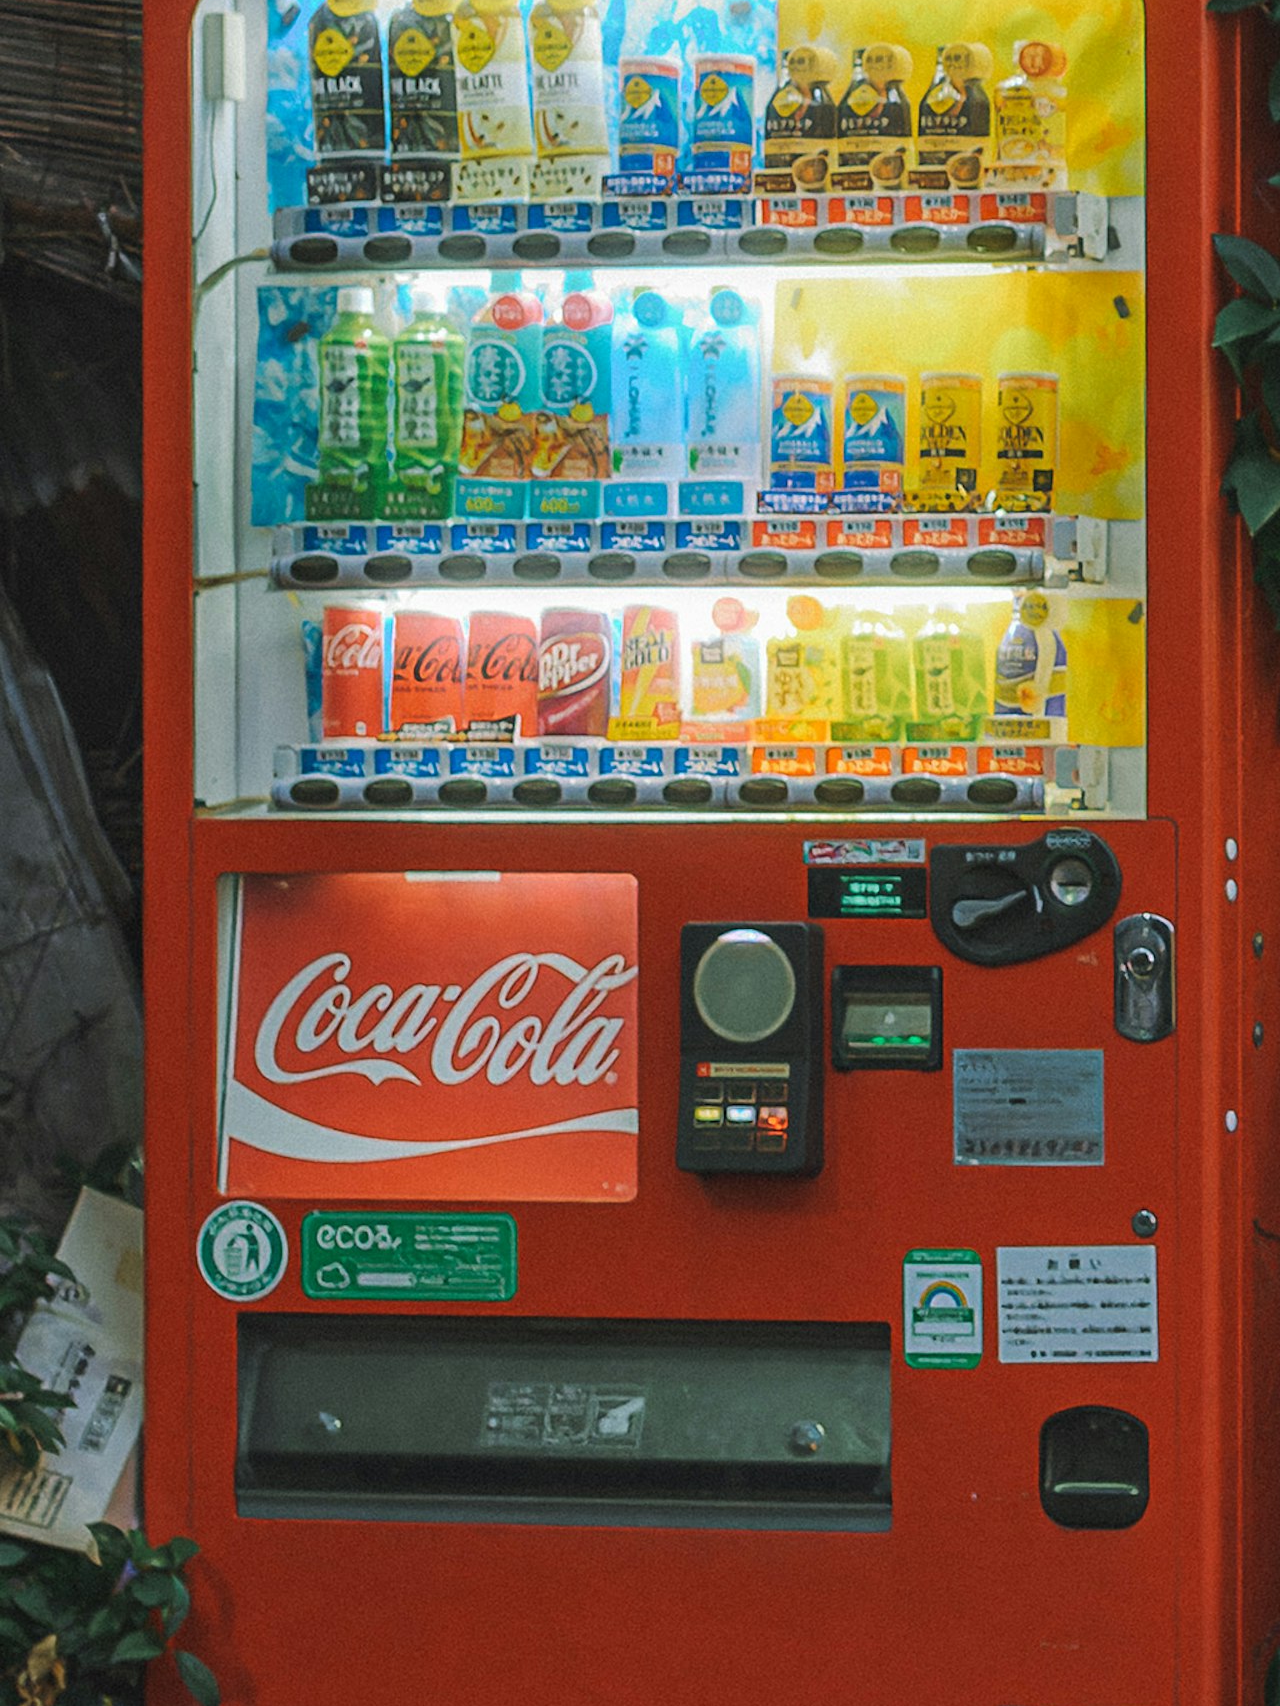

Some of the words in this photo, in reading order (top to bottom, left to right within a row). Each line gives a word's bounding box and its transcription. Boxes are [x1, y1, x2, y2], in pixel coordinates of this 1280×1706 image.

[539, 651, 598, 692] Pepper
[552, 642, 581, 669] Dr
[254, 951, 639, 1088] Coca-Cola
